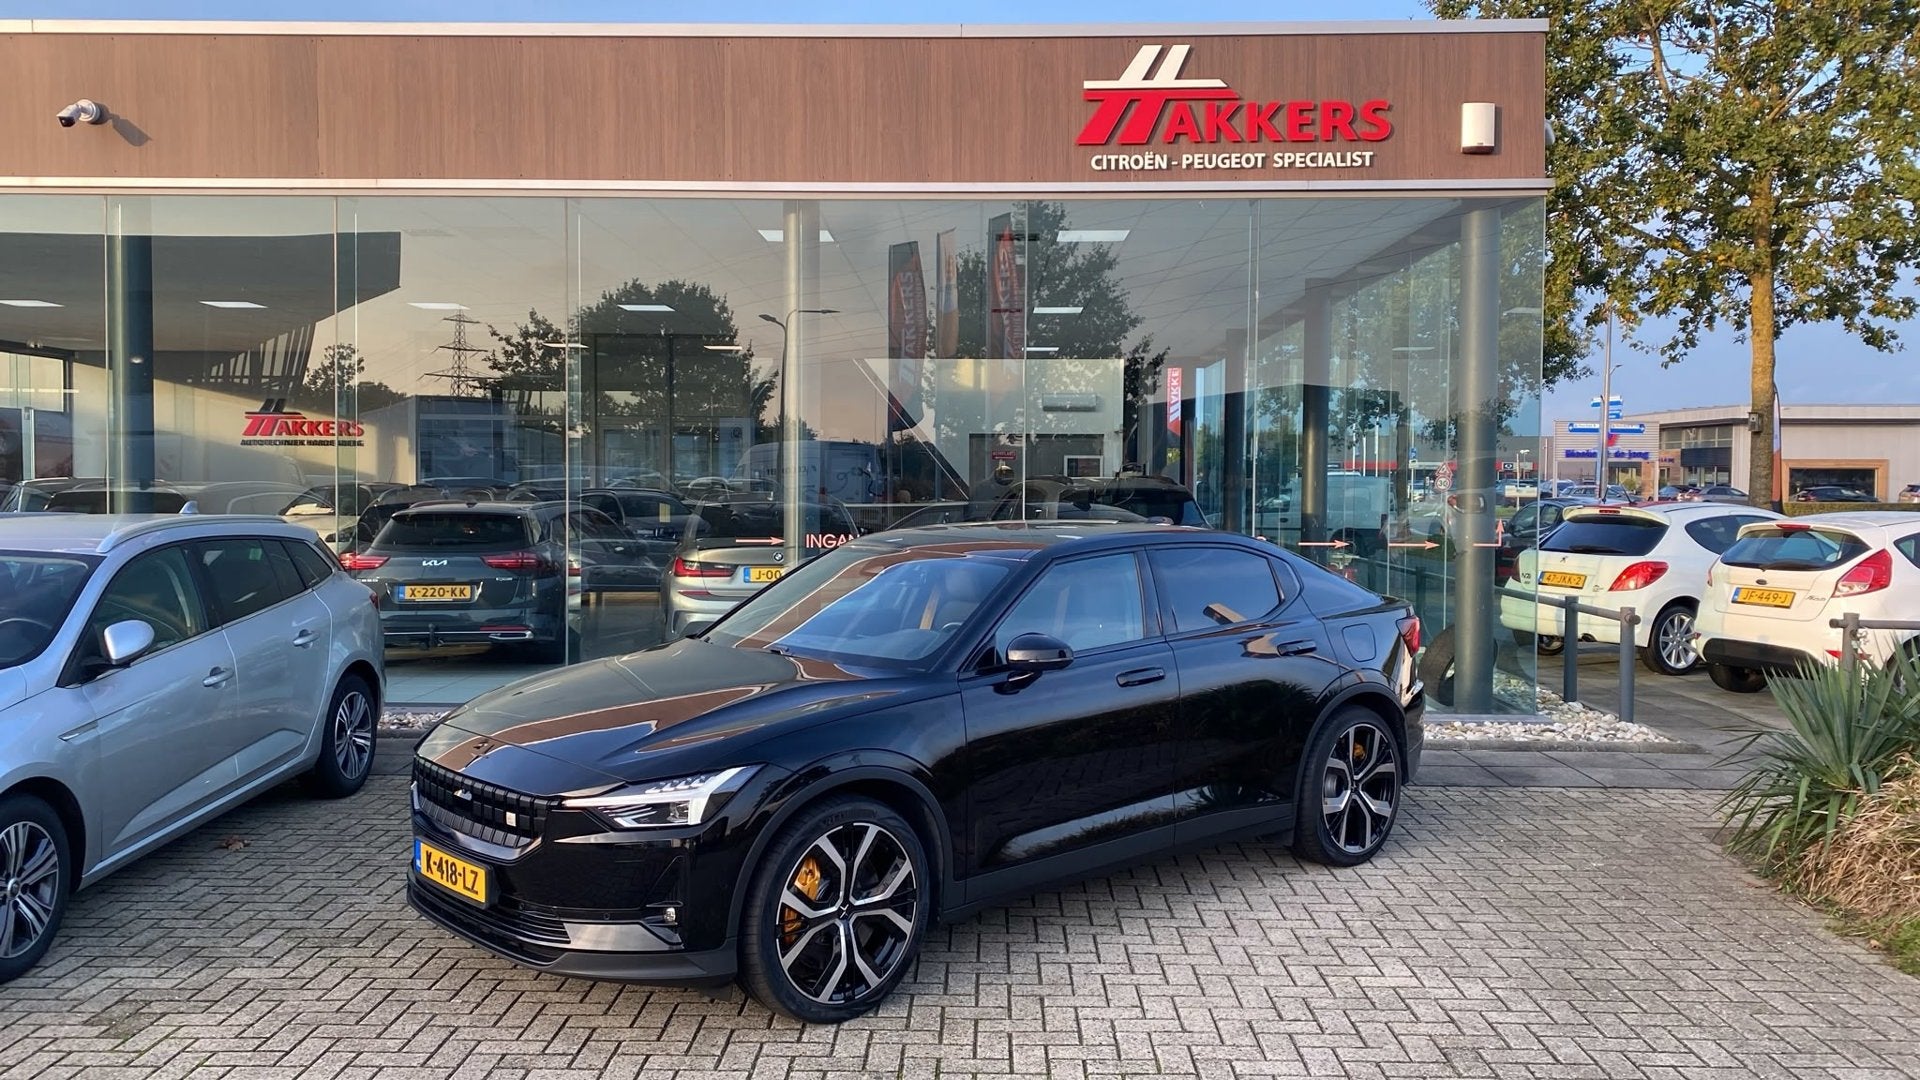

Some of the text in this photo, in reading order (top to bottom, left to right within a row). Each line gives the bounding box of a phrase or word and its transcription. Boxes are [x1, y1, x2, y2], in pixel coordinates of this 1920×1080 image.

[1075, 44, 1393, 144] HAKKERS
[1090, 151, 1169, 171] CITROËN
[1181, 153, 1266, 169] PEUGEOT
[1273, 151, 1374, 168] SPECIALIST
[242, 399, 365, 436] HAKKERS
[409, 587, 467, 598] X-220-KK
[1743, 591, 1788, 604] JF-449-J
[425, 850, 479, 896] K-418-LZ
